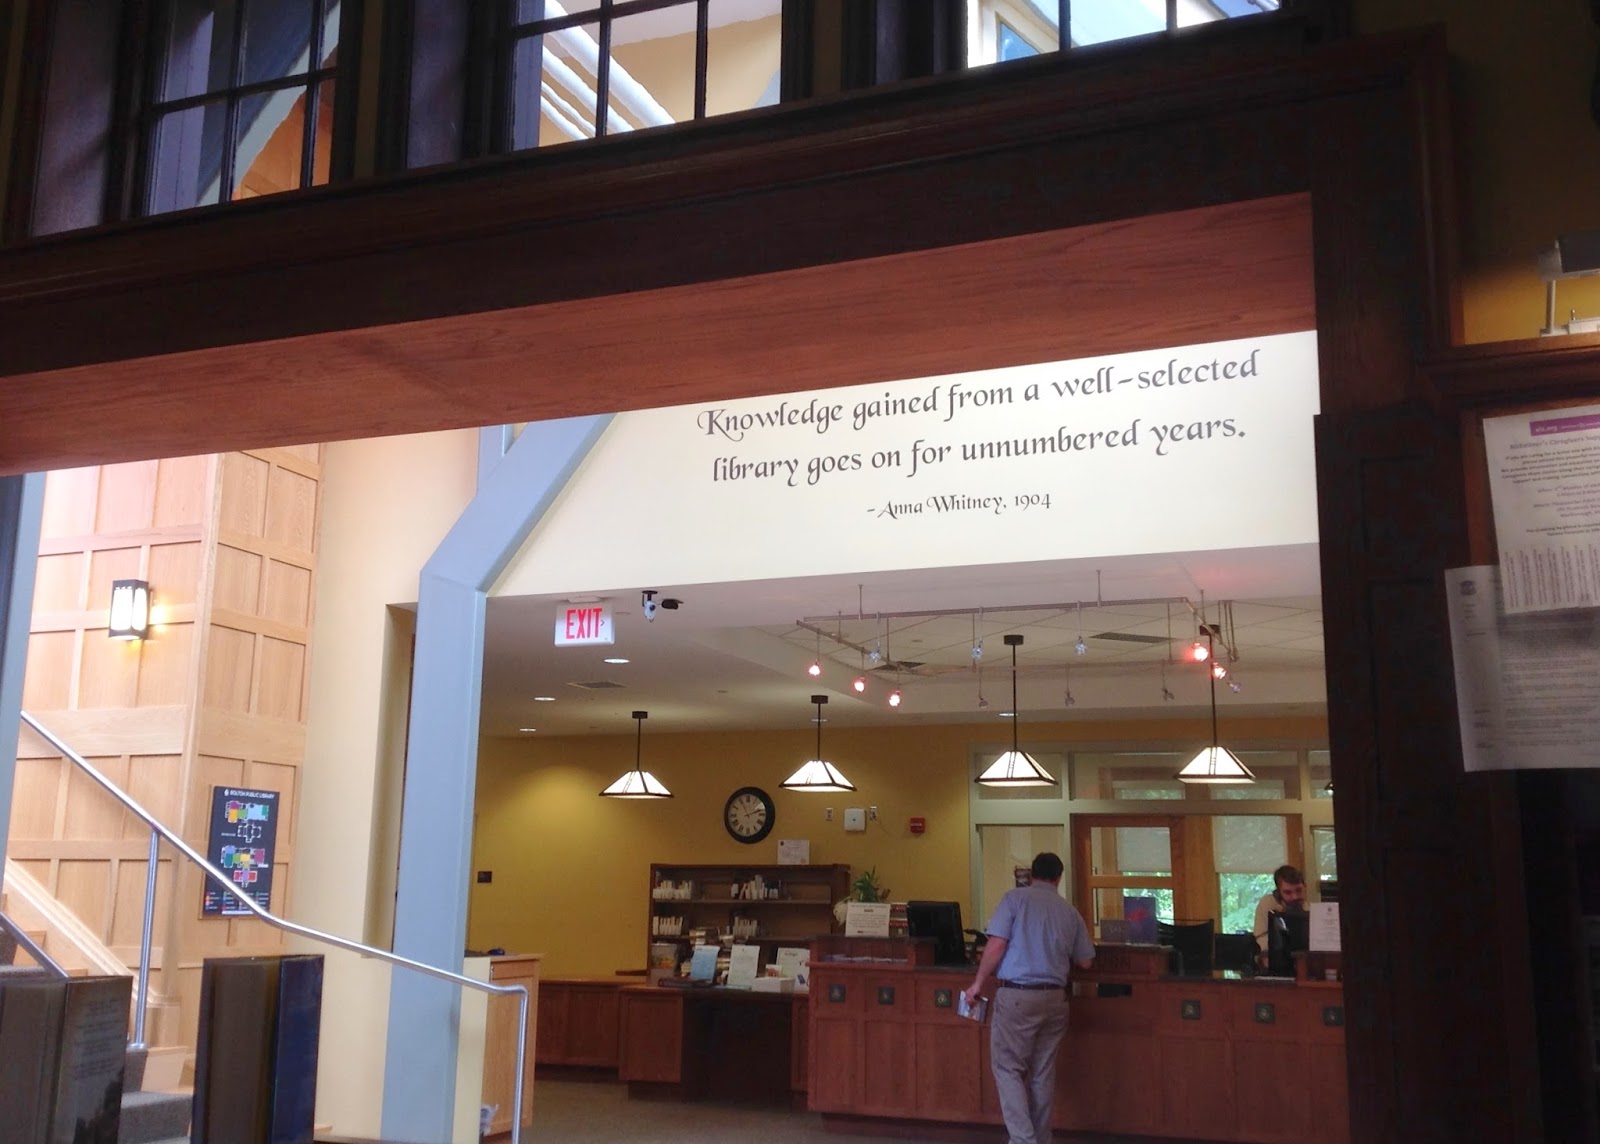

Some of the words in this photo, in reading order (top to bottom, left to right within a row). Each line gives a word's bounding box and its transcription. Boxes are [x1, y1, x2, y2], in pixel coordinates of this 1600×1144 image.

[696, 398, 844, 442] Knowledge
[853, 386, 941, 430] gained
[943, 383, 1013, 422] from
[1025, 385, 1040, 402] a
[713, 456, 800, 487] library
[808, 453, 863, 485] goes
[871, 450, 902, 468] on
[906, 440, 952, 478] for
[961, 418, 1141, 461] unnumbered
[1149, 418, 1246, 456] years.
[925, 494, 1008, 516] Whitney,
[1014, 493, 1052, 511] 1904
[565, 607, 603, 640] EXIT
